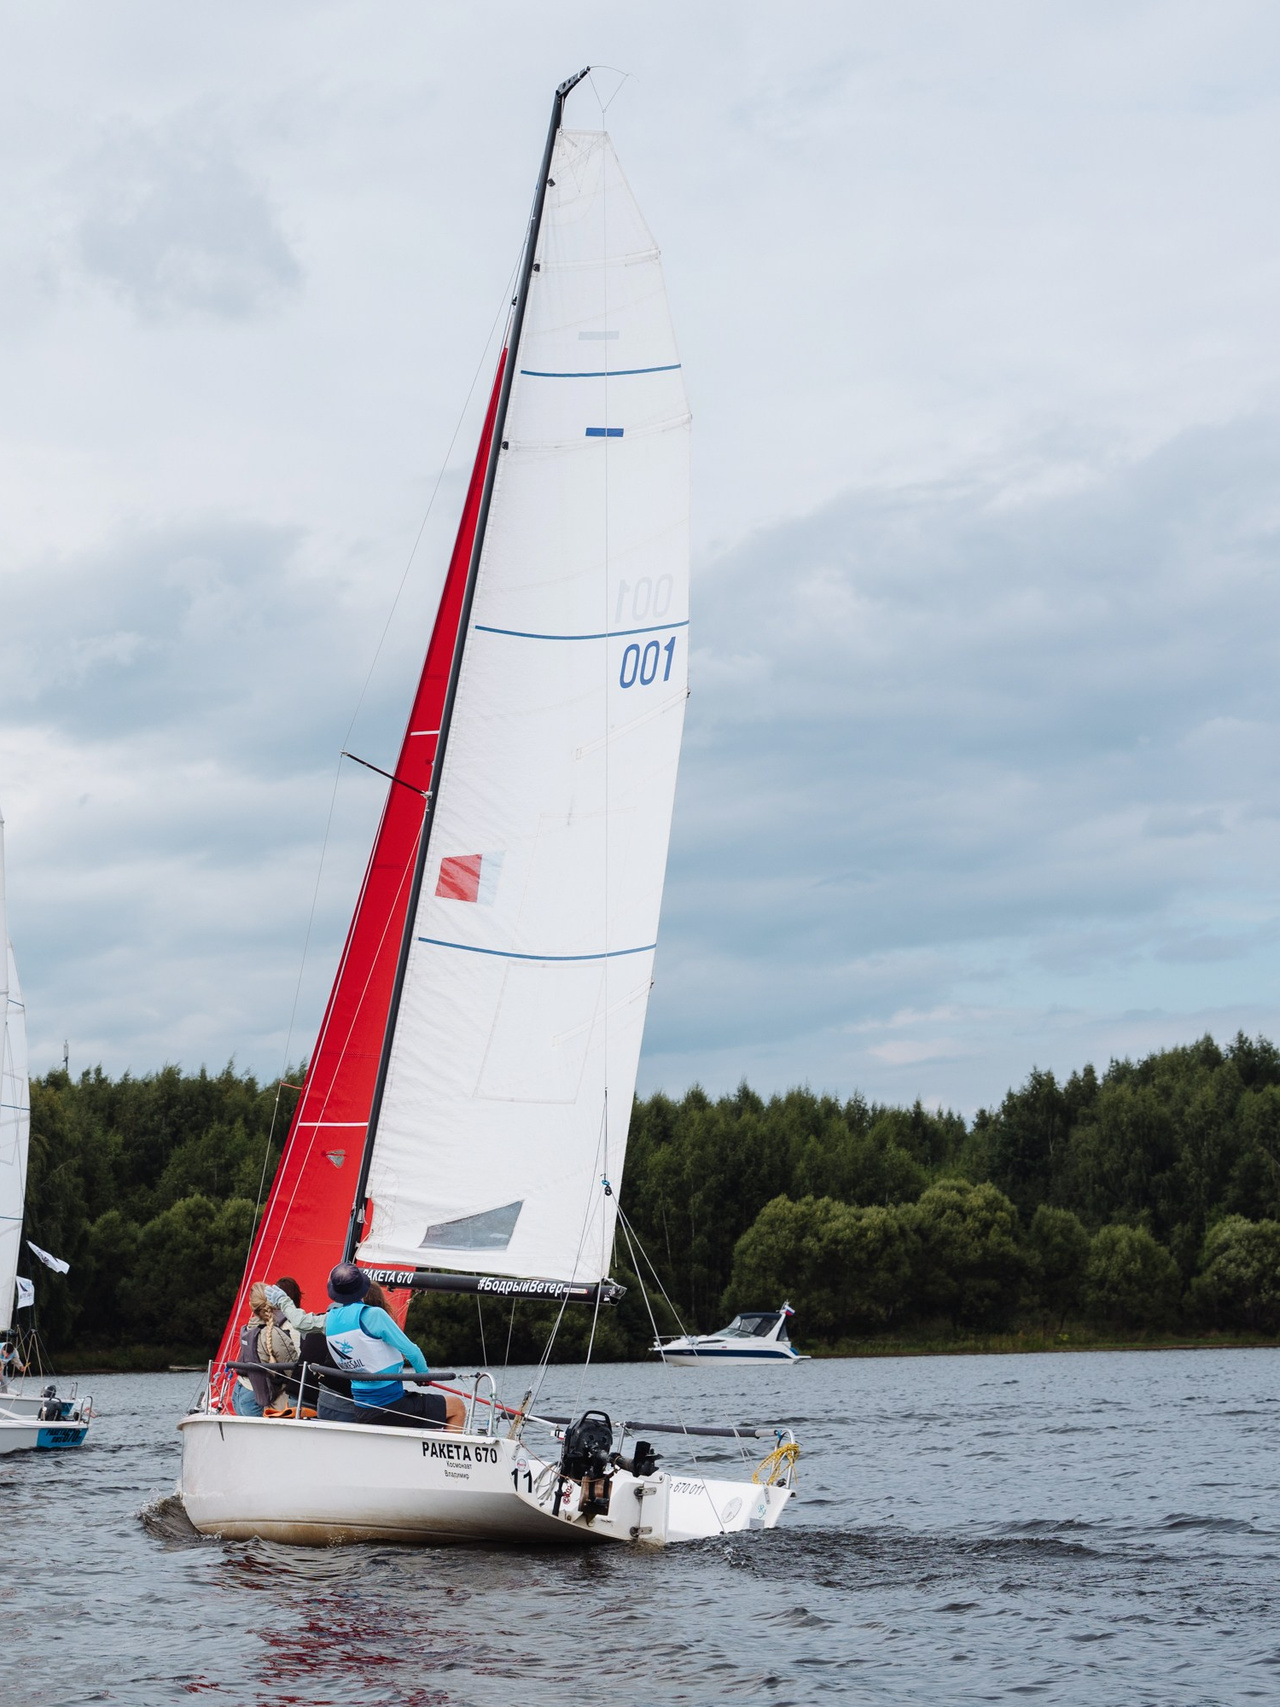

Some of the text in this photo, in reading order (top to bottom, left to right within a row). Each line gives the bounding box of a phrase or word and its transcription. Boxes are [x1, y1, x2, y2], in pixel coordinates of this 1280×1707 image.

[619, 636, 676, 689] 001
[396, 1272, 415, 1284] 670
[477, 1276, 564, 1297] #БодрыйВетер
[422, 1441, 498, 1464] РАКЕТА 670
[511, 1468, 533, 1493] 11
[673, 1482, 689, 1494] 670
